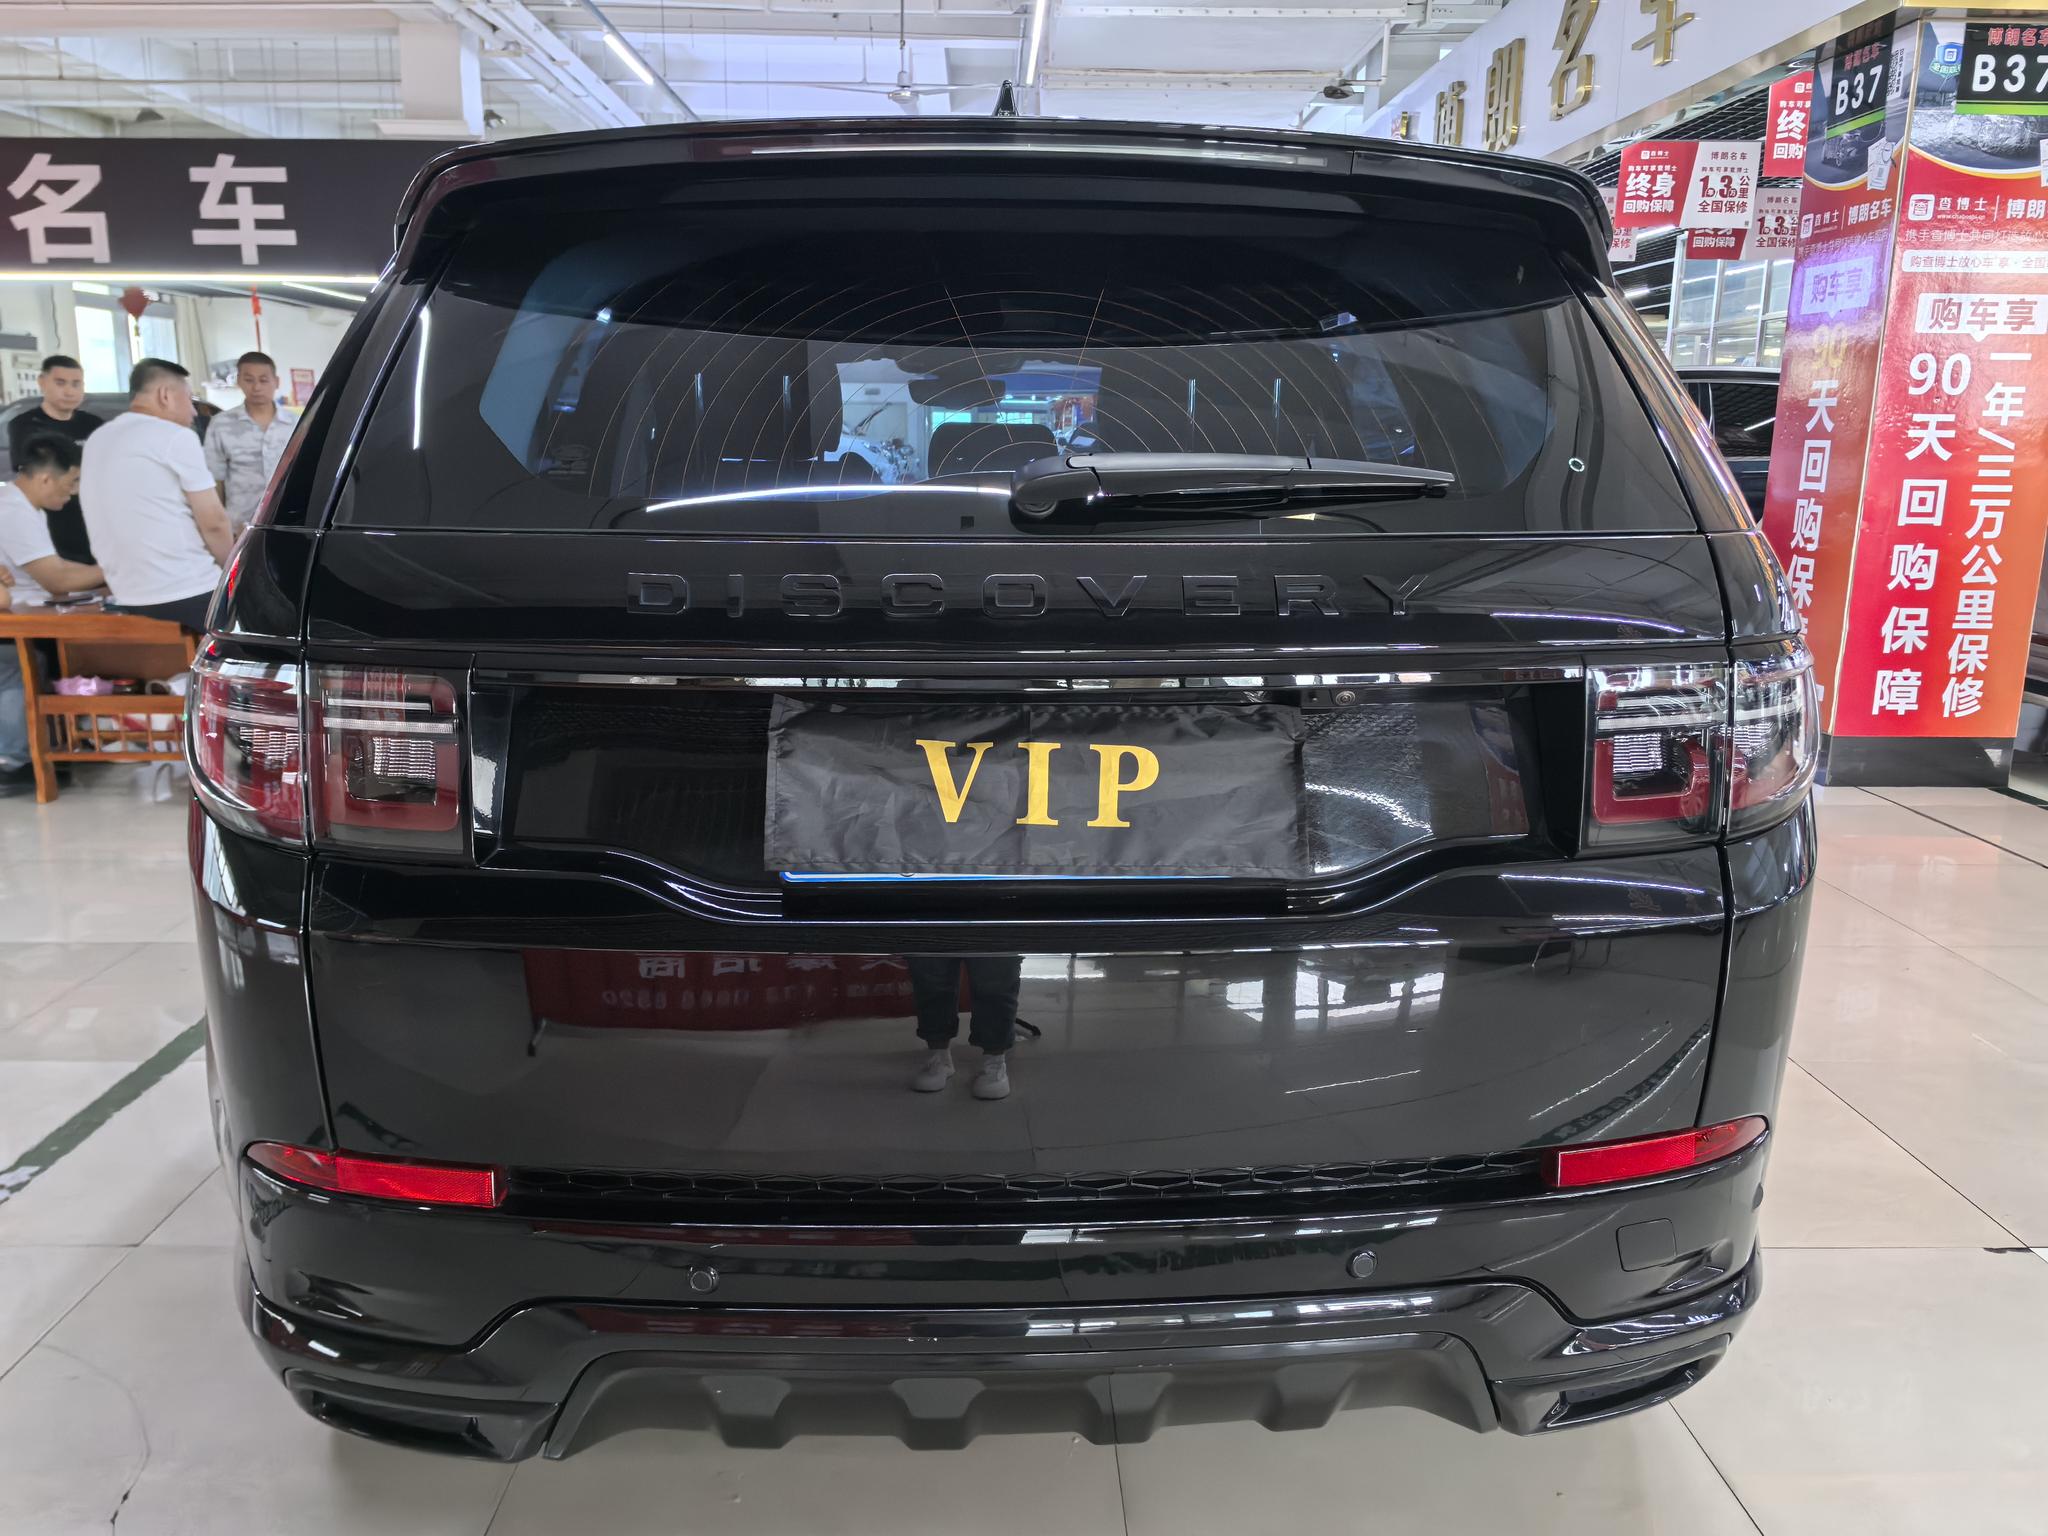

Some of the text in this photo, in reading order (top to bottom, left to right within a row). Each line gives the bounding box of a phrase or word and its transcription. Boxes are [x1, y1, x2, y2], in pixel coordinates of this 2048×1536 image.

[1835, 64, 1883, 116] B37
[1625, 172, 1676, 198] 终身
[8, 153, 298, 265] 名车
[1622, 199, 1675, 213] 回购保障
[1697, 200, 1748, 213] 全国保修
[1848, 198, 1892, 226] 博朗名车
[1811, 267, 1863, 305] 购车享
[1928, 297, 2038, 331] 购车享
[627, 571, 1430, 617] DISCOVERY
[915, 739, 1161, 828] VIP
